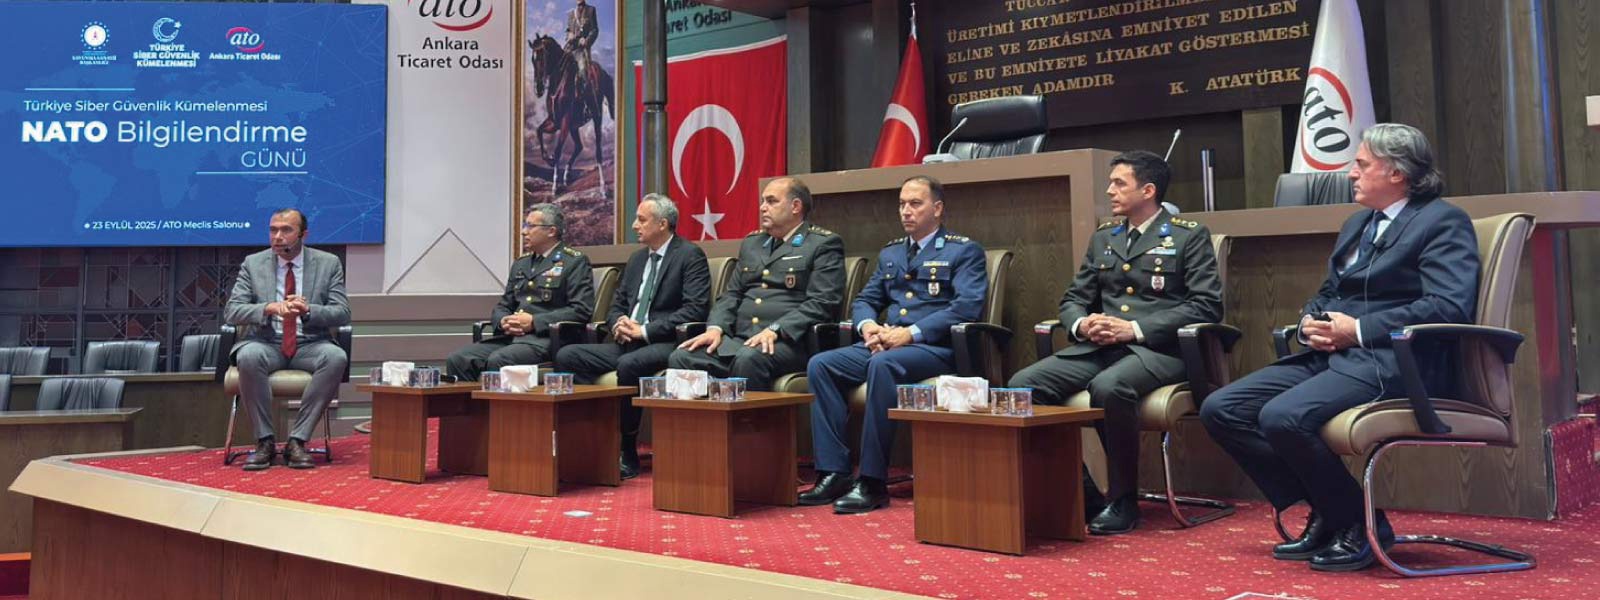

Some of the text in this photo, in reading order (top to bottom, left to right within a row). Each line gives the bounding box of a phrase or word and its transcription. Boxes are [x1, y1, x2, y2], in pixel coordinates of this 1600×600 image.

[230, 31, 260, 45] ato
[947, 19, 1015, 43] ÜRETİMİ
[1000, 42, 1021, 55] VE
[1121, 13, 1210, 38] EMNİYET
[422, 36, 479, 50] Ankara
[948, 21, 1310, 84] VE BU EMNİYETE LİYAKAT GÖSTERMESİ
[397, 54, 504, 68] Ticaret Odası
[948, 67, 1302, 105] GEREKEN ADAMDIR K. ATATÜRK
[24, 100, 268, 113] Türkiye Siber Güvenlik Kümelenmesi
[1303, 86, 1351, 153] ato
[21, 120, 307, 147] NATO Bilgilendirme
[241, 148, 306, 168] GÜNÜ
[92, 221, 103, 229] 23
[104, 220, 134, 230] EYLÜL
[135, 221, 157, 229] 2025
[162, 220, 182, 229] ATO
[183, 220, 212, 229] Meclis
[213, 220, 244, 229] Salonu
